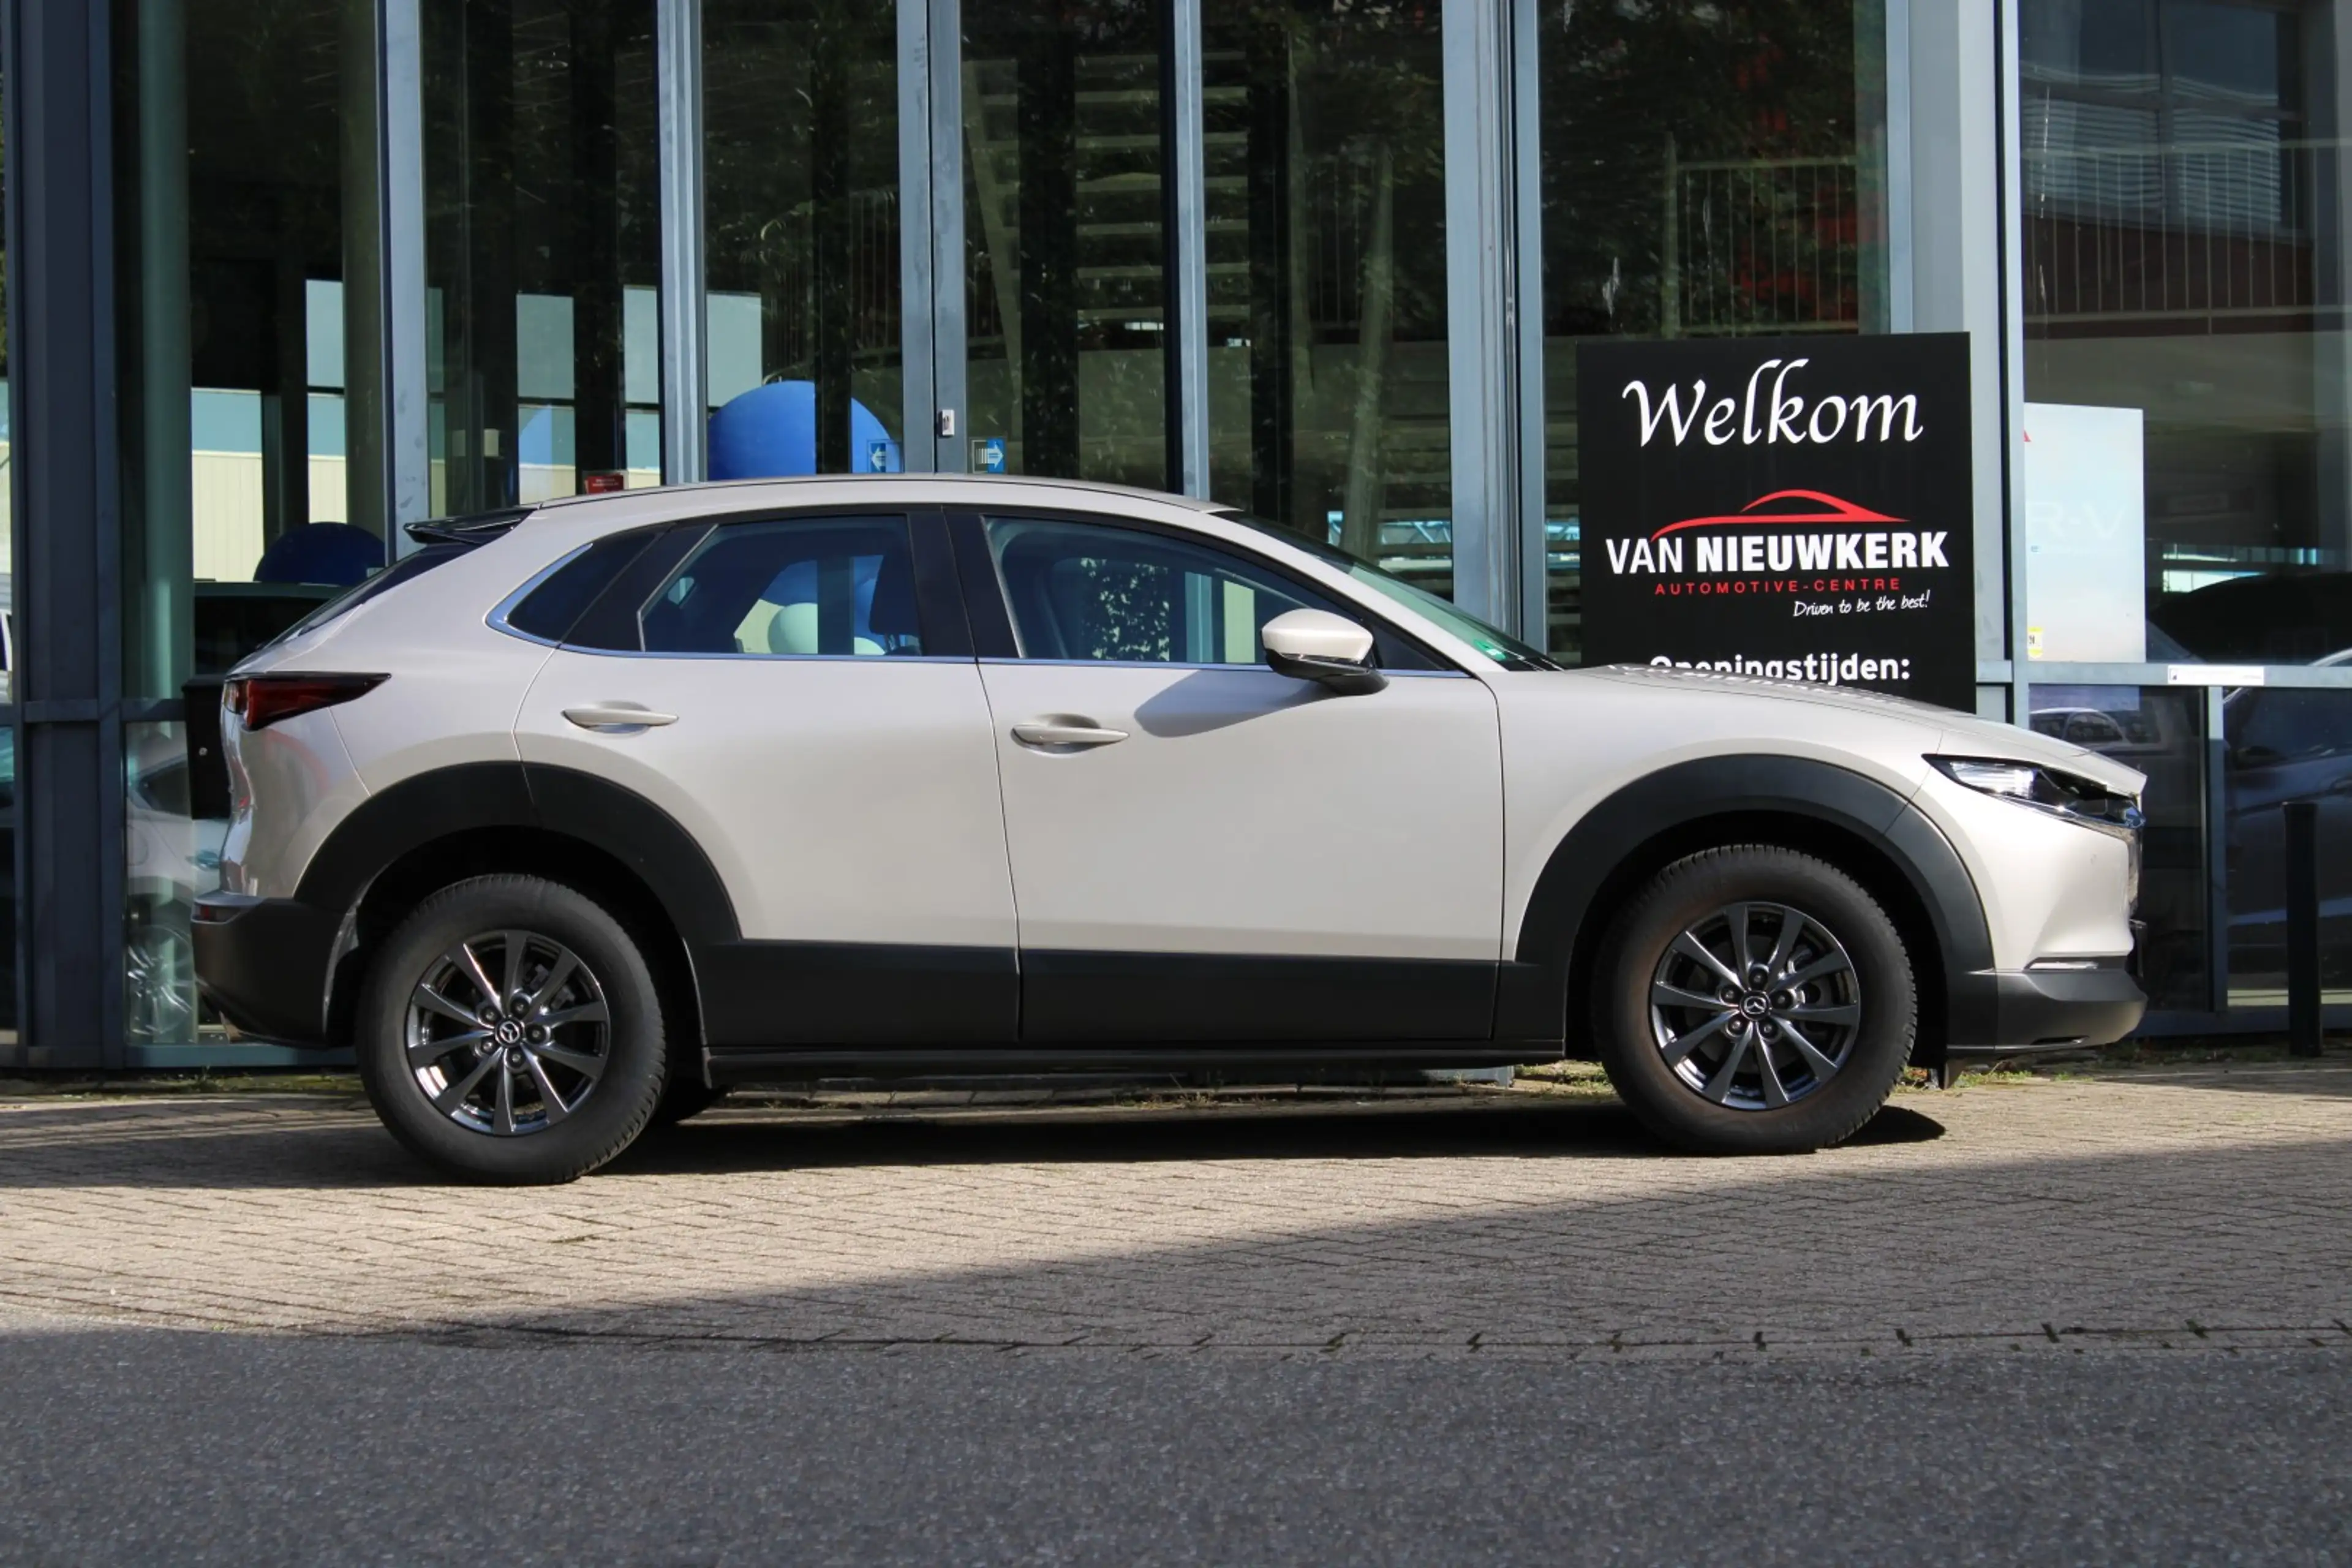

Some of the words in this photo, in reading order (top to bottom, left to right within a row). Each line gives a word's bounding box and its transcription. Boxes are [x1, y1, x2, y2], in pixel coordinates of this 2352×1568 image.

[1622, 359, 1923, 447] Welkom
[1606, 538, 1683, 575] VAN
[1697, 531, 1950, 573] NIEUWKERK
[1656, 577, 1899, 595] AUTOMOTIVE-CENTRE
[1793, 600, 1833, 617] Driven
[1838, 599, 1852, 614] to
[1856, 598, 1871, 612] be
[1875, 595, 1897, 611] the
[1901, 589, 1931, 609] best!
[1650, 653, 1910, 686] ningstijden:
